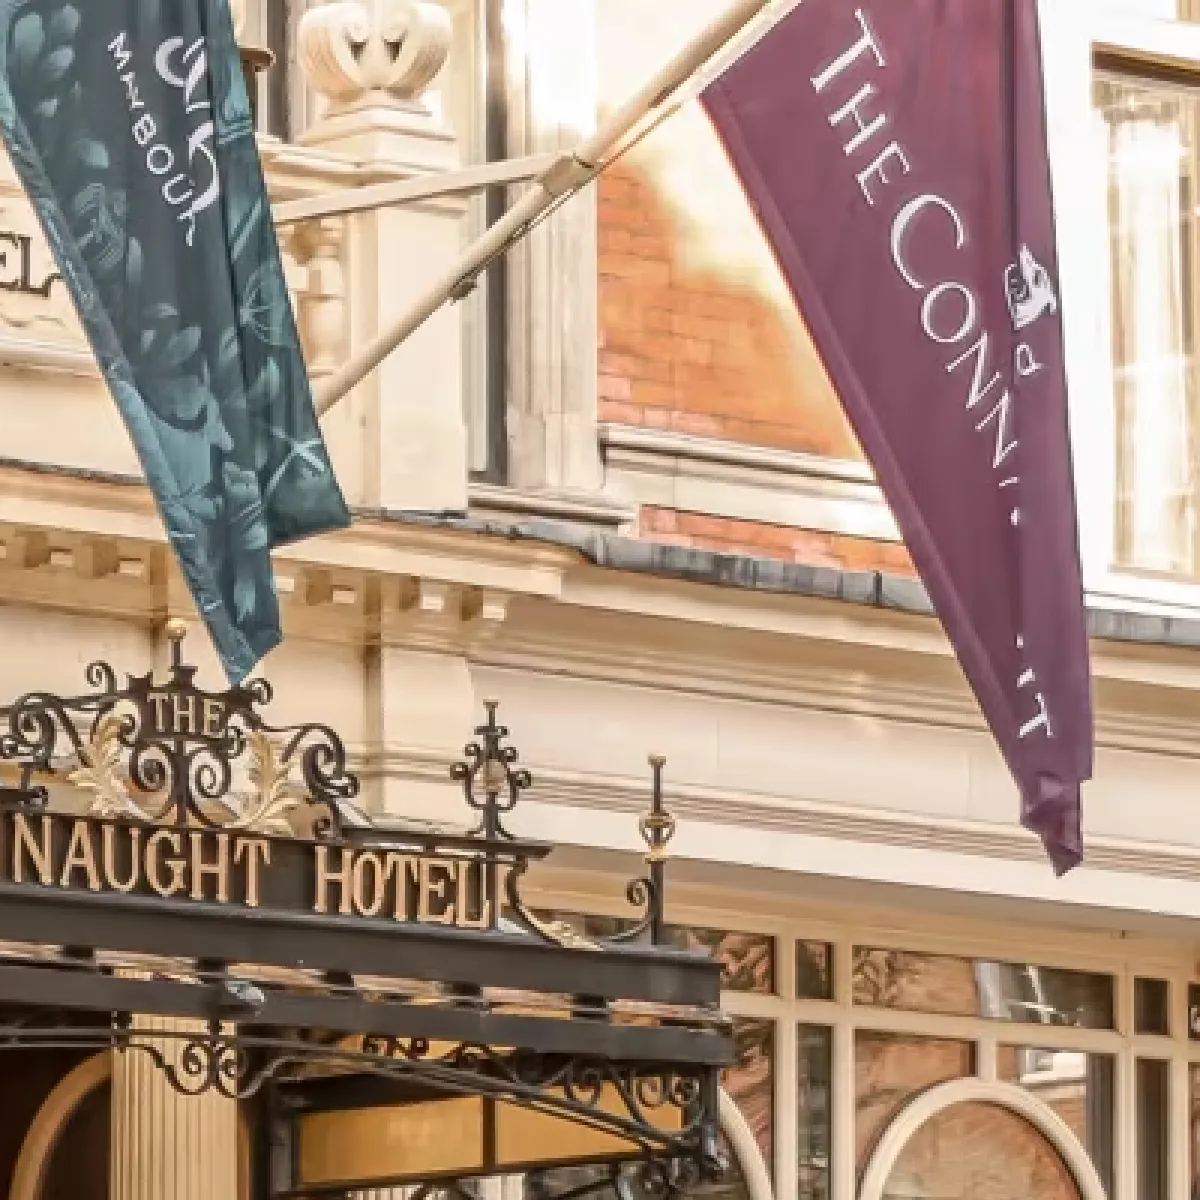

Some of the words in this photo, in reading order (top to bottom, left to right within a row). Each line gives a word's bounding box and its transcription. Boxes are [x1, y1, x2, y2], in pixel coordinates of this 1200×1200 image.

[810, 8, 910, 206] THE
[146, 691, 228, 740] THE
[314, 845, 492, 930] HOTEL
